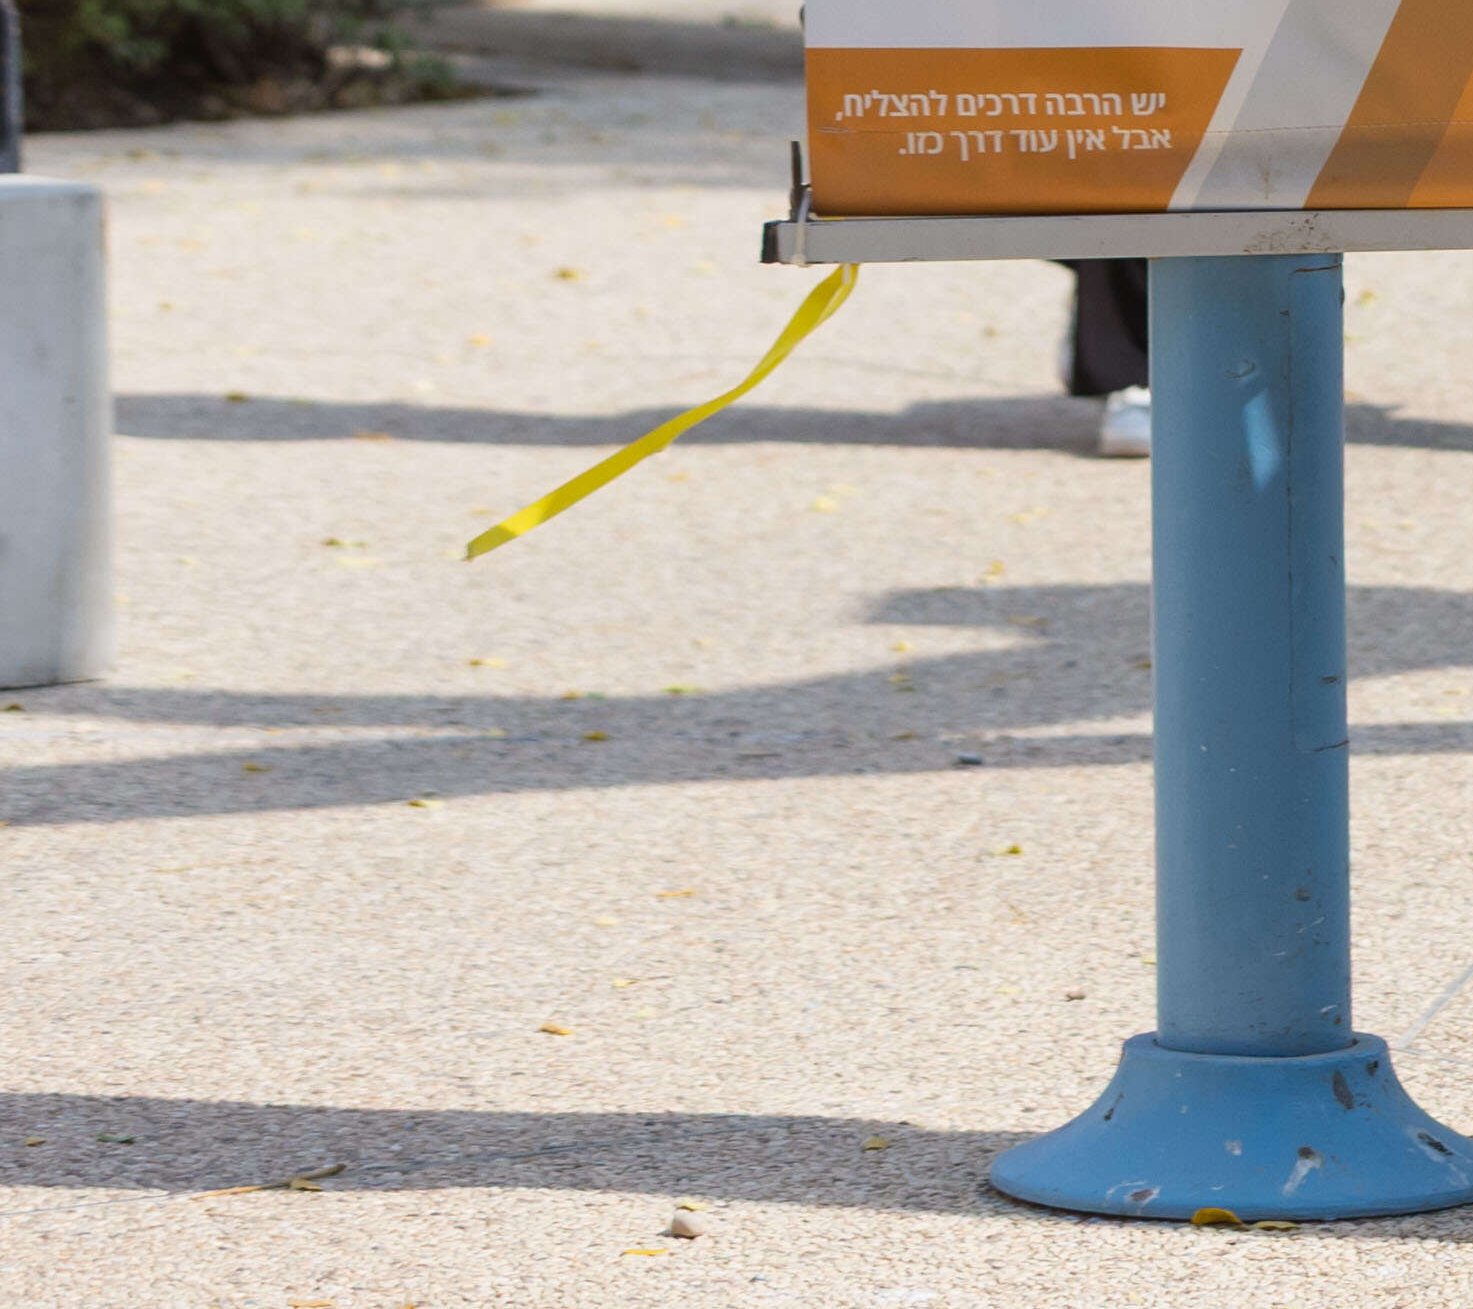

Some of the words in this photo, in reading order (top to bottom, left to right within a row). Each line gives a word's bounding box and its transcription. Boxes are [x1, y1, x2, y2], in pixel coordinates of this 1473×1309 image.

[835, 89, 948, 122] להצליח,
[955, 93, 1038, 117] דרכים
[1044, 93, 1123, 116] הרבה
[1130, 92, 1166, 117] יש
[899, 131, 944, 155] כזו.
[949, 130, 1003, 162] דרך
[1010, 130, 1058, 153] עוד
[1066, 129, 1105, 160] אין
[1111, 125, 1172, 150] אבל
